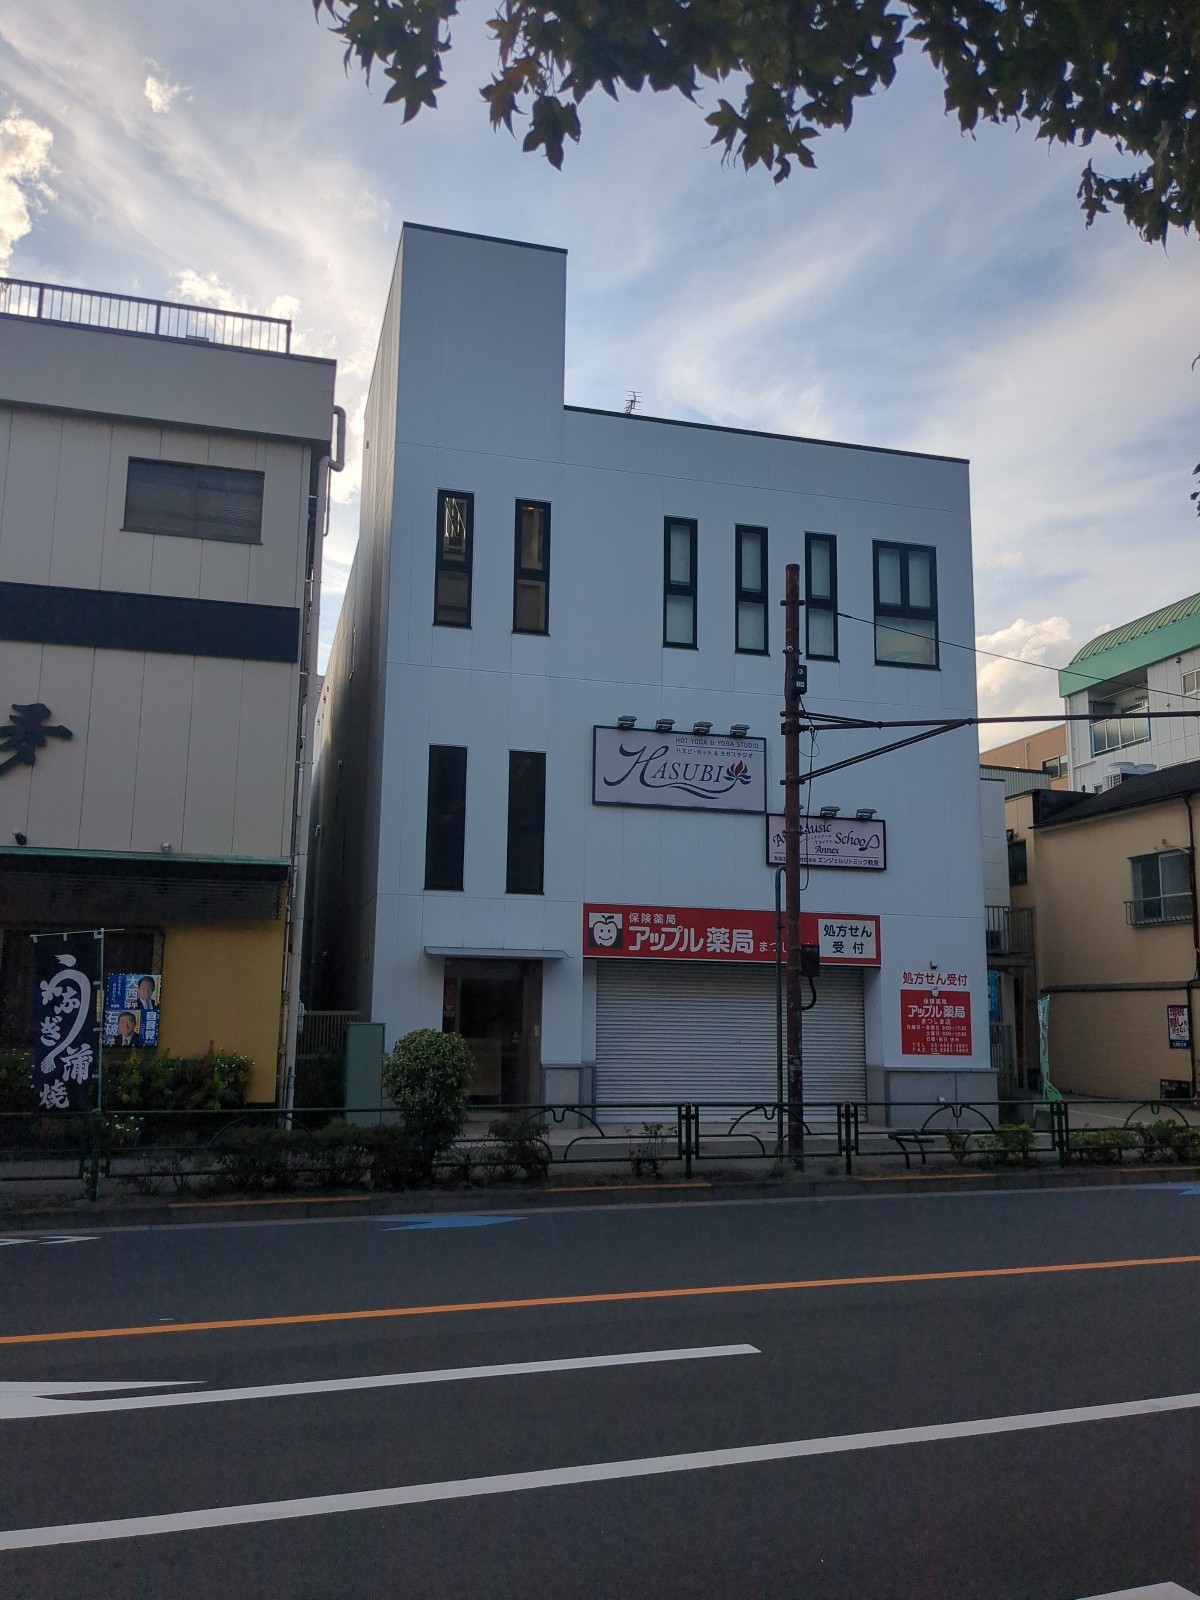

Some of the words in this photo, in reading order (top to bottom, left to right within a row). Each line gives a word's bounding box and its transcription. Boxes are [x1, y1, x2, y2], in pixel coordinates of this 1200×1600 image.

[603, 742, 725, 789] HASUBI
[814, 845, 840, 855] Annex
[628, 912, 676, 925] 保険薬局
[823, 924, 872, 938] 処方せん
[628, 924, 754, 954] アップル薬局
[832, 940, 865, 955] 受付
[902, 971, 968, 987] 処方せん受付
[907, 1005, 966, 1019] アップル薬局
